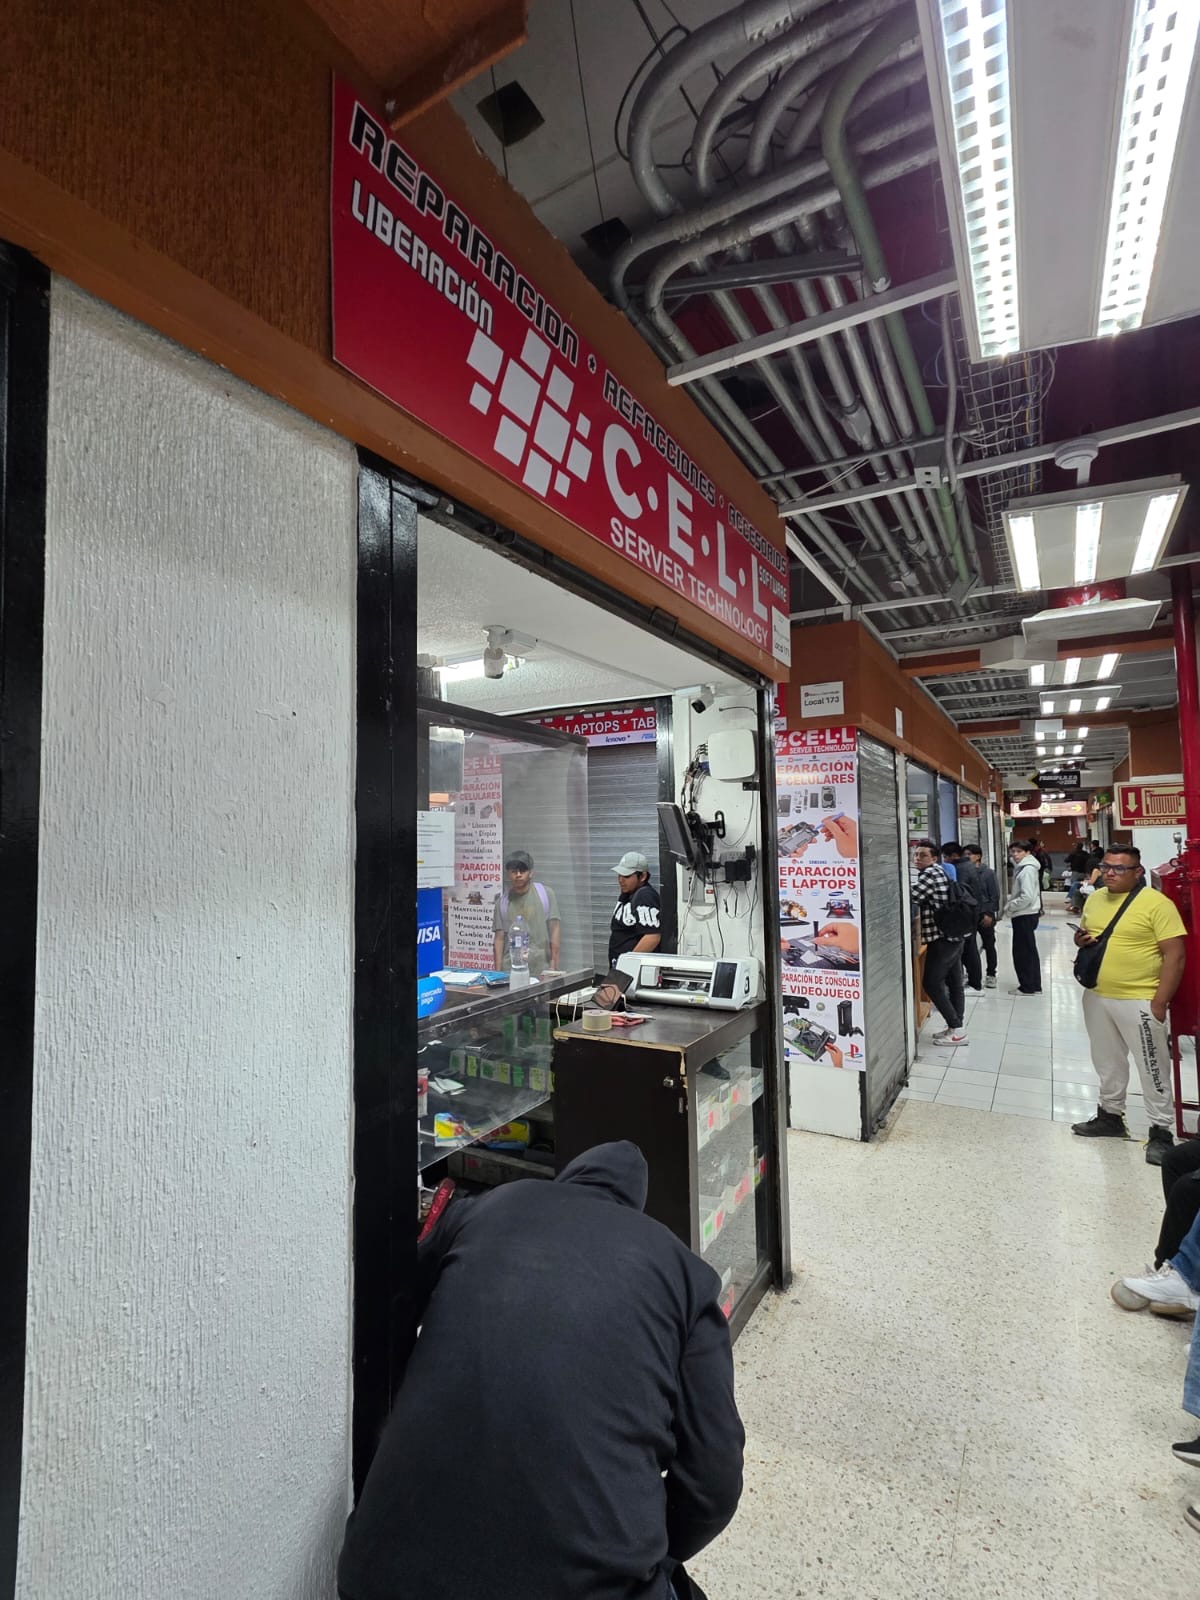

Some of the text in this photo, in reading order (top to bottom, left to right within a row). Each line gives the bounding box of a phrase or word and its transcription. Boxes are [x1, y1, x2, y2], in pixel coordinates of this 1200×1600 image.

[352, 179, 494, 336] LIBERACIÓN
[350, 100, 788, 577] REPARACION REFACCIONES ACCESORIOS
[610, 517, 769, 647] SERVER TECHNOLOGY
[804, 696, 839, 706] Local 173
[631, 716, 656, 730] TAB
[790, 744, 855, 754] SERVER TECHNOLOGY
[777, 760, 854, 774] EPARACIÓN
[786, 773, 855, 786] CELULARES
[779, 864, 857, 877] EPARACIÓN
[779, 878, 856, 889] E LAPTOPS
[814, 975, 823, 985] DE
[825, 976, 860, 988] CONSOLAS
[780, 984, 860, 1000] E VIDEOJUEGO
[1140, 1010, 1157, 1060] Abercrombie
